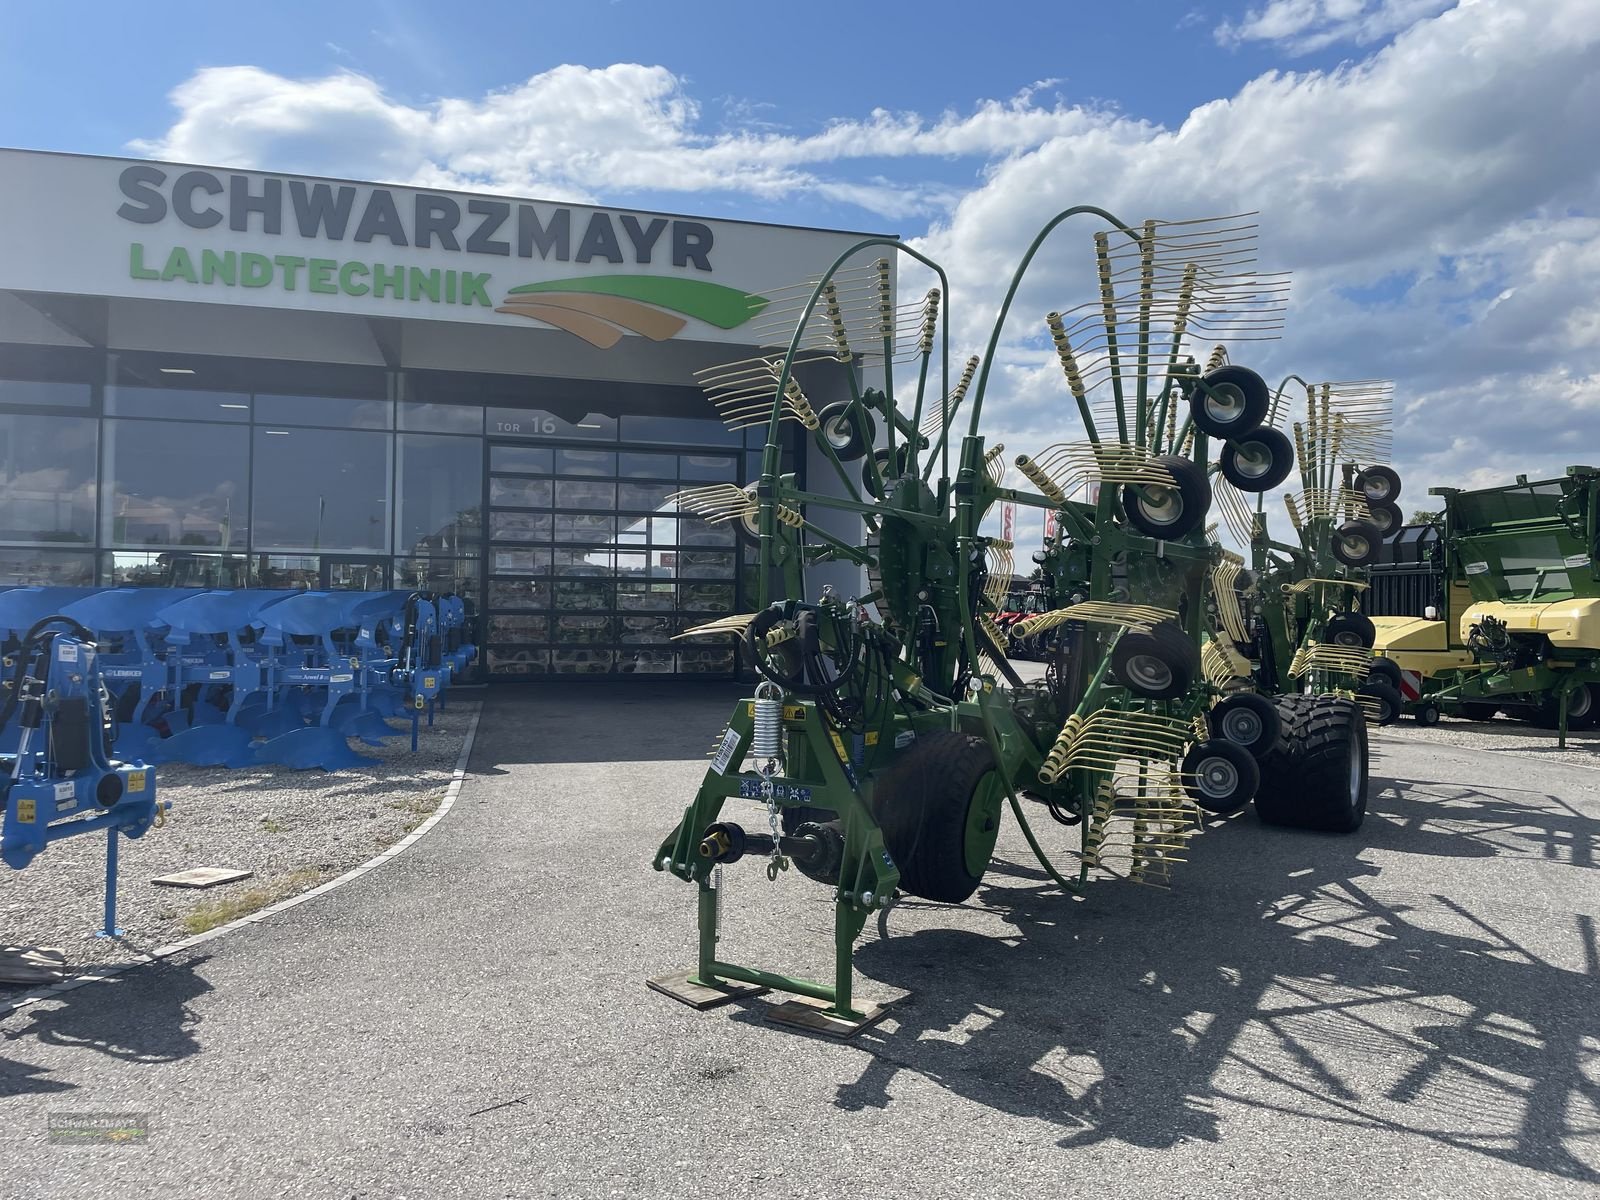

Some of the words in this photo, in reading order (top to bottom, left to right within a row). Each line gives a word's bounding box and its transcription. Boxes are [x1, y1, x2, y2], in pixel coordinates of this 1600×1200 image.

[116, 165, 714, 272] SCHWARZMAYR
[130, 242, 493, 307] LANDTECHNIK
[496, 422, 520, 433] TOR
[531, 416, 556, 434] 16
